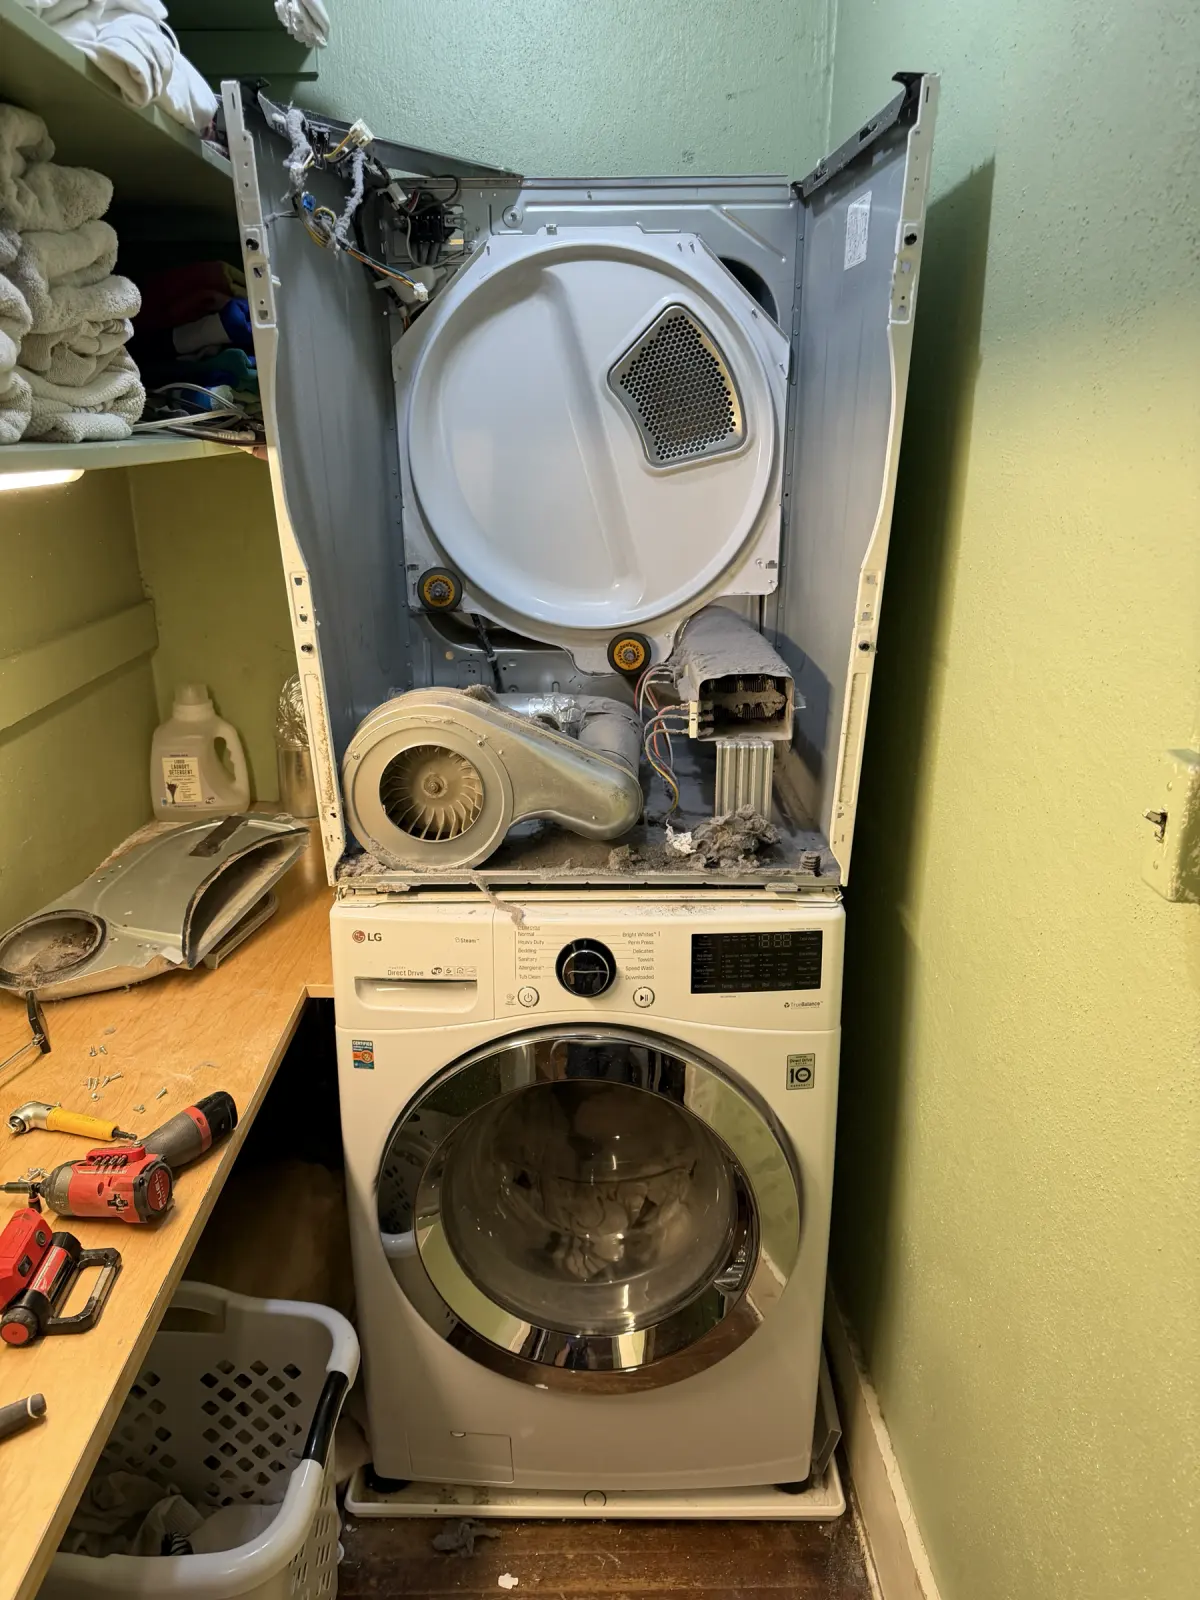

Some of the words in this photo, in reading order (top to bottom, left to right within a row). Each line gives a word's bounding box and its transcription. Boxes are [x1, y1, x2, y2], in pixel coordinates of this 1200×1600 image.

[367, 932, 382, 942] LG
[789, 1067, 812, 1084] 10
[155, 1173, 164, 1208] FUEL
